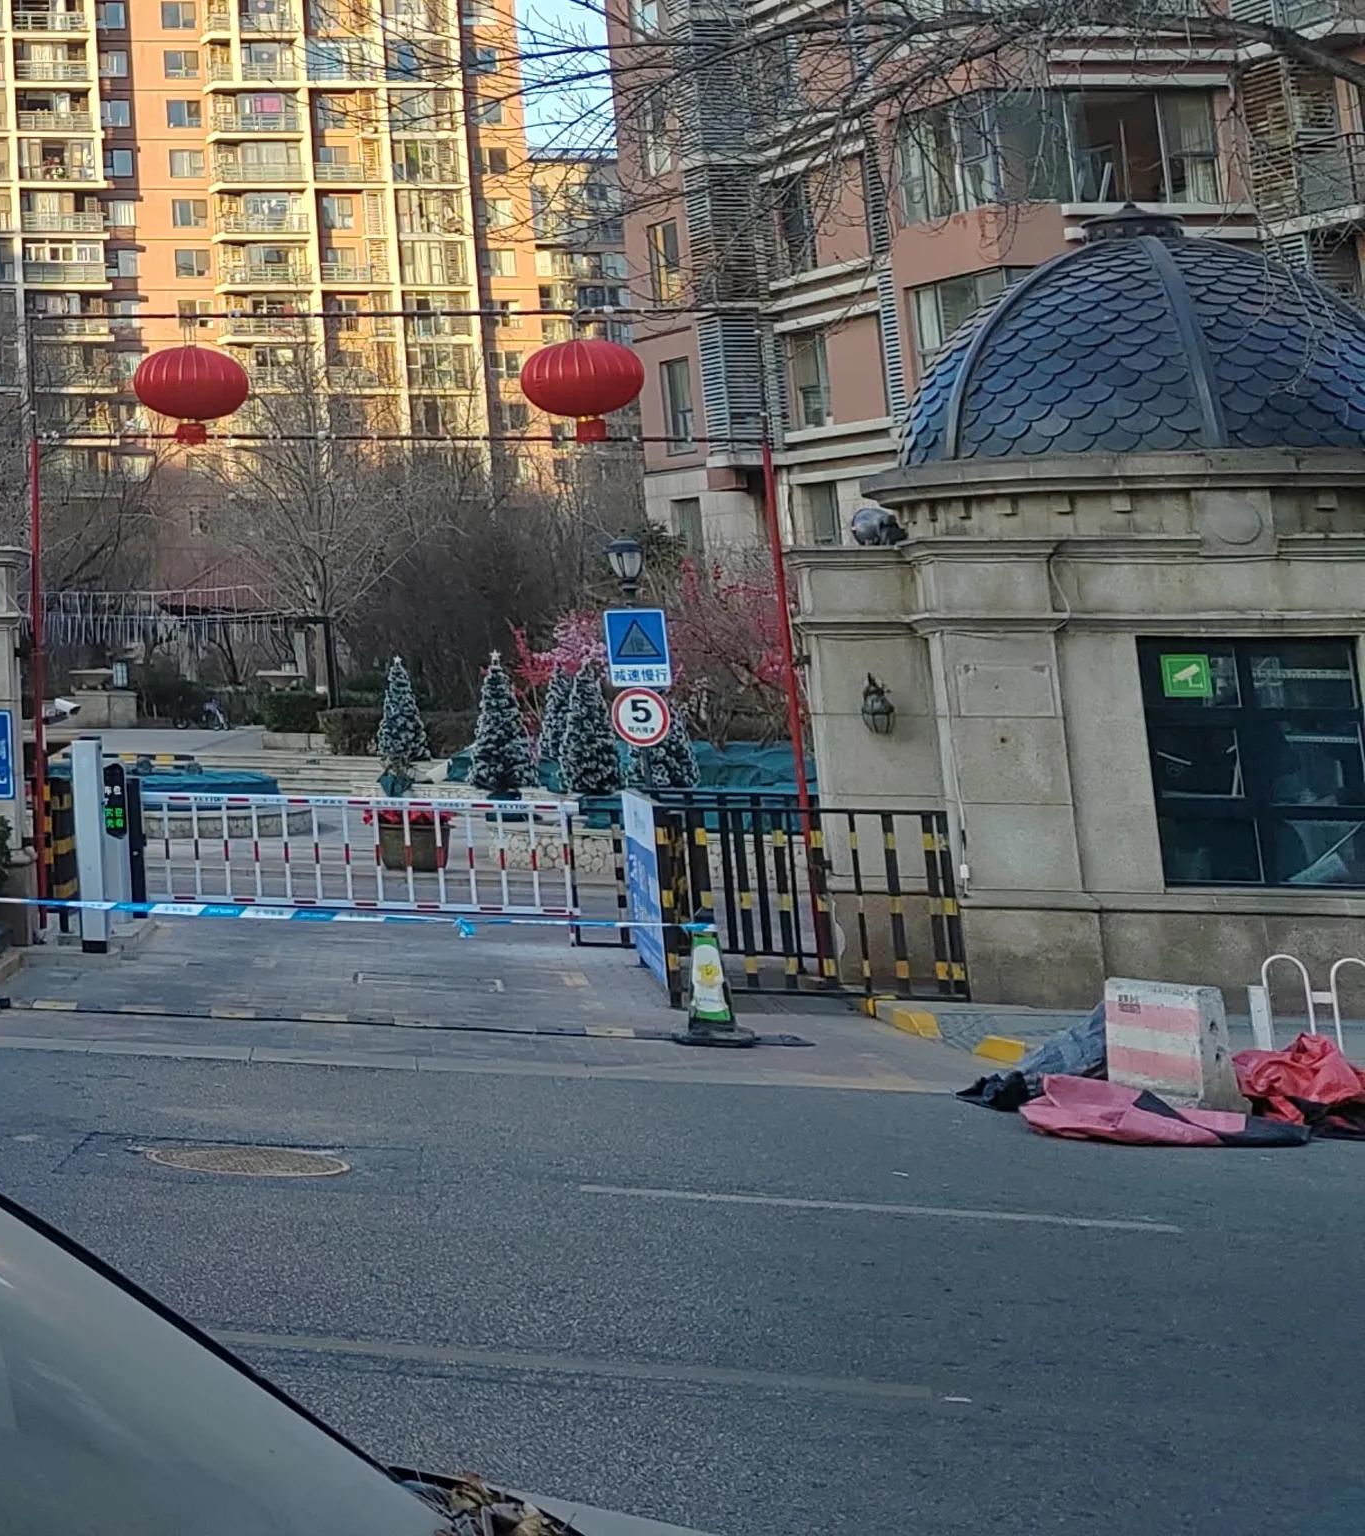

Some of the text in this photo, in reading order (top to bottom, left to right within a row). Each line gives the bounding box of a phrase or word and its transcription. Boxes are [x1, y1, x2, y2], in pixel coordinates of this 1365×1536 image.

[613, 668, 668, 682] 减速慢行
[631, 699, 652, 723] 5
